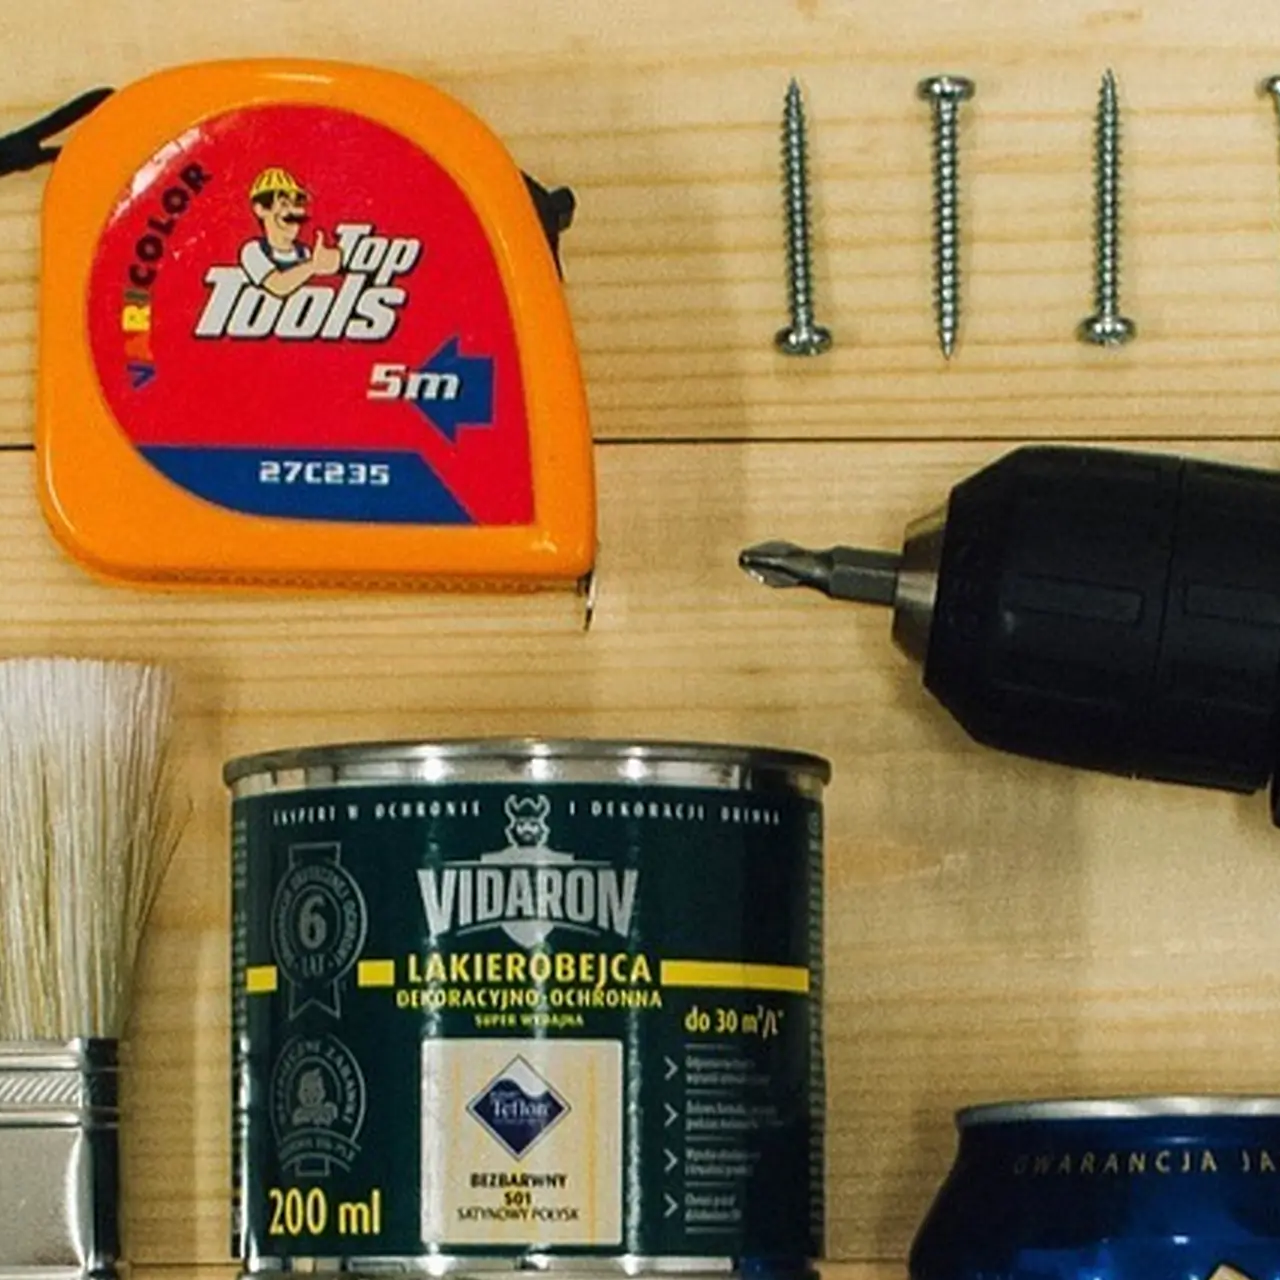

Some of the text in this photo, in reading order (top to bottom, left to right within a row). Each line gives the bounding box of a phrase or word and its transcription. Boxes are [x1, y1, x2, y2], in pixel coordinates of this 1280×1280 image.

[122, 161, 213, 388] VARICOLOR
[335, 223, 422, 287] Top
[194, 265, 408, 341] Tools
[366, 362, 460, 401] 5m
[258, 460, 391, 486] 27C235
[299, 893, 328, 950] 6
[416, 868, 639, 939] VIDARON
[407, 952, 652, 988] LAKIEROBEJCA
[684, 1004, 711, 1033] do
[715, 1008, 739, 1034] 30
[470, 1171, 569, 1189] BEZBARWNY
[267, 1186, 383, 1236] 200 ml
